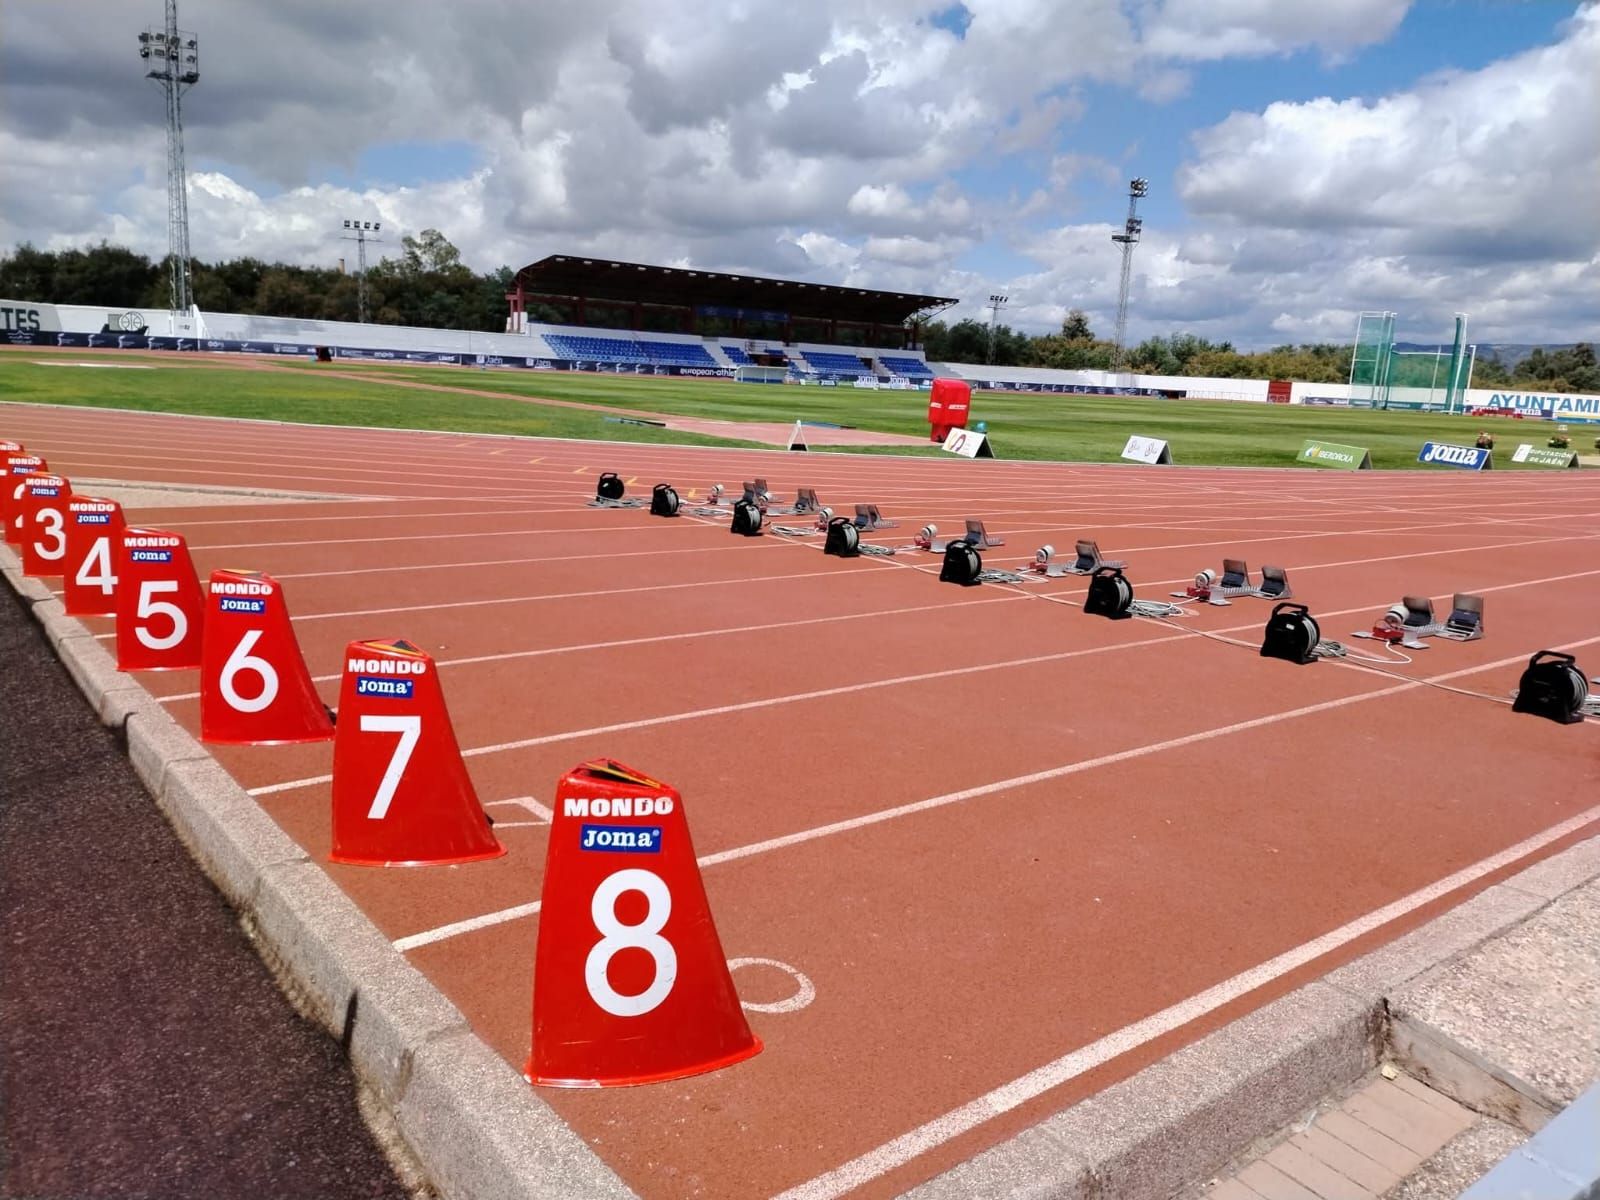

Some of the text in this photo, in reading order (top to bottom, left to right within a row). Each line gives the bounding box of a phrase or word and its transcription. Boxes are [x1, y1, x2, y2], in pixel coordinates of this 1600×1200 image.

[0, 307, 40, 330] TES
[1487, 393, 1600, 414] AYUNTAMI
[8, 457, 42, 465] MONDO
[25, 478, 65, 487] MONDO
[69, 503, 116, 512] MONDO
[33, 508, 67, 561] 3
[124, 537, 180, 548] MONDO
[75, 536, 119, 595] 4
[211, 582, 273, 596] MONDO
[134, 580, 188, 650] 5
[219, 629, 279, 713] 6
[348, 658, 427, 675] MONDO
[359, 714, 422, 820] 7
[563, 797, 674, 817] MONDO
[584, 868, 678, 1017] 8
